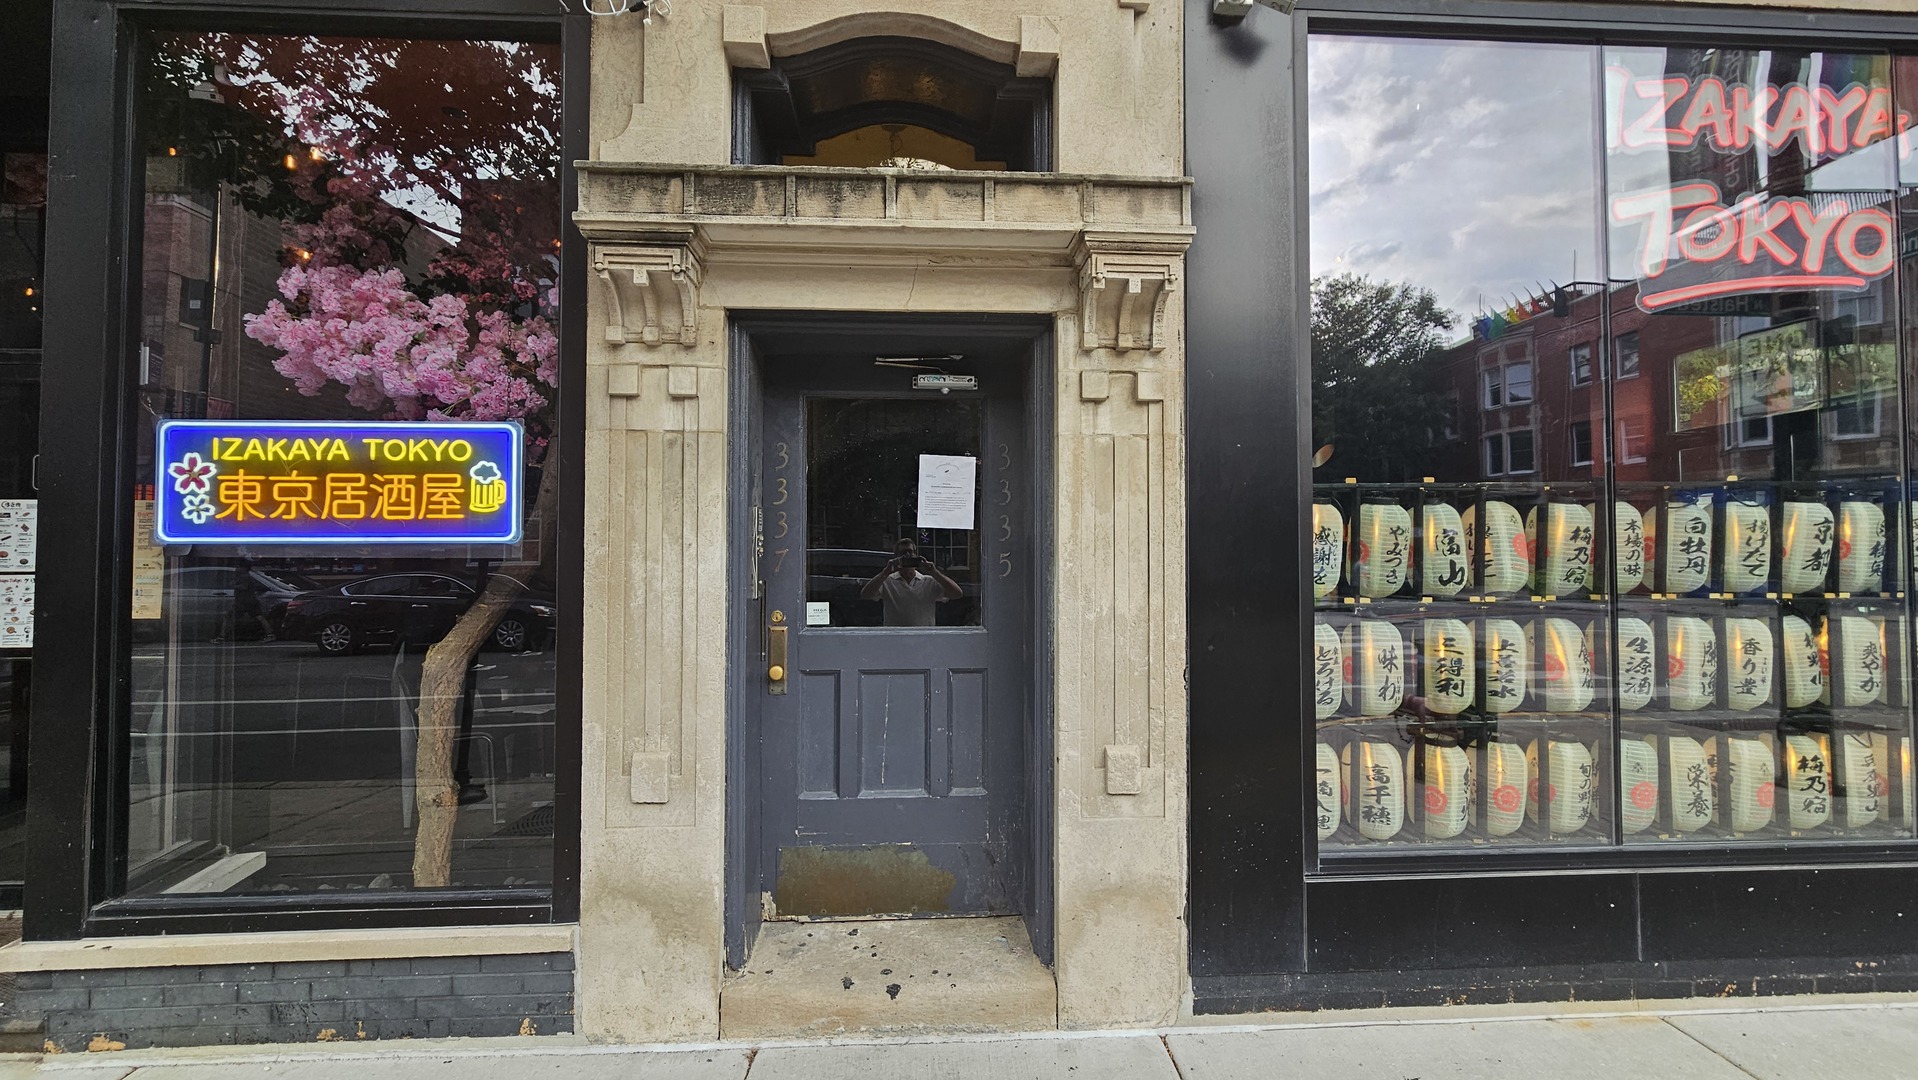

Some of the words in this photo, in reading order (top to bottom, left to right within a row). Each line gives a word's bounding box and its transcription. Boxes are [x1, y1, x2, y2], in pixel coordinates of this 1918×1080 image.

[1605, 67, 1909, 158] IZAKAYA
[1613, 184, 1895, 277] TOKYO
[212, 437, 349, 461] IZAKAYA
[363, 438, 472, 462] TOKYO
[216, 469, 466, 521] 東京居酒屋
[772, 442, 790, 574] 3337
[1384, 525, 1405, 584] やみつき
[1438, 528, 1466, 586] 富山
[1623, 518, 1642, 577] 本場の味
[1678, 516, 1708, 575] 白牡丹
[1801, 516, 1834, 575] 京都
[1797, 754, 1827, 814] 梅乃宿
